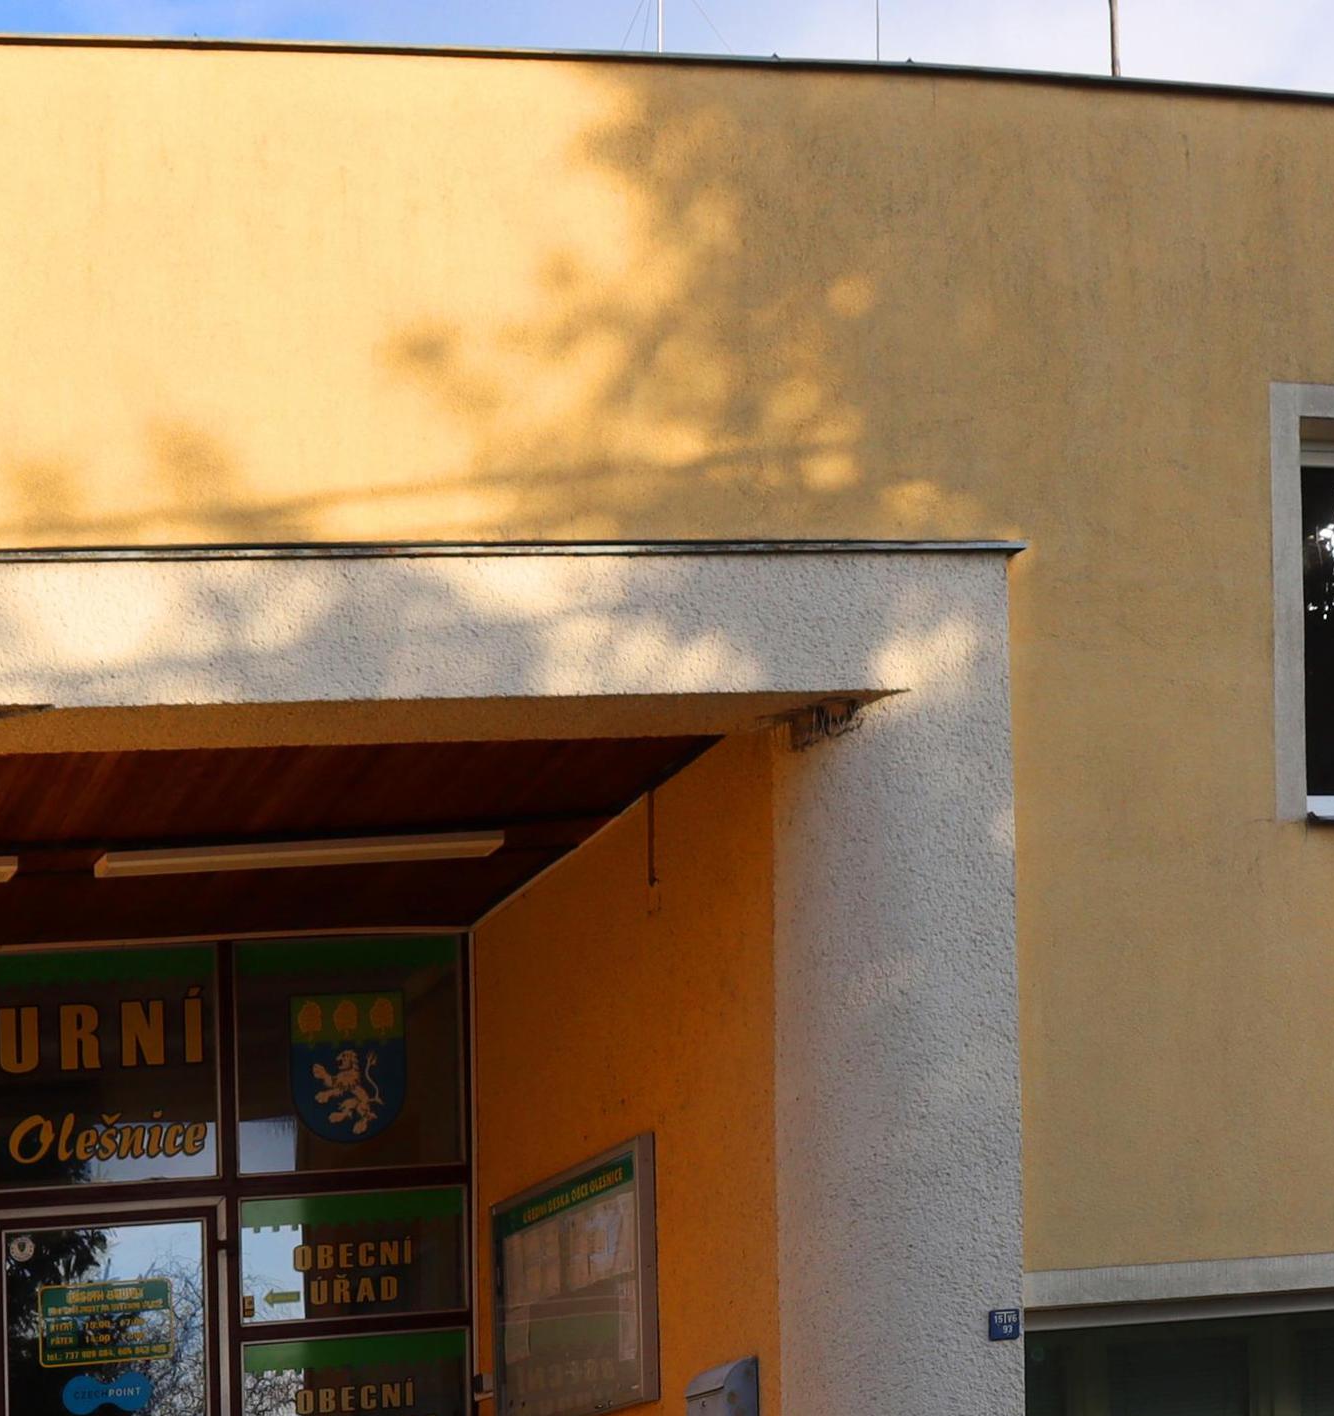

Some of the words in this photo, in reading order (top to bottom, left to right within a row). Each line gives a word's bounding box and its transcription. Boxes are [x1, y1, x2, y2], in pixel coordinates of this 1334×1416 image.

[8, 1110, 208, 1164] Olešnice
[294, 1236, 413, 1272] OBECNÍ
[310, 1273, 398, 1305] ÚŘAD
[296, 1378, 414, 1415] OBECNÍ
